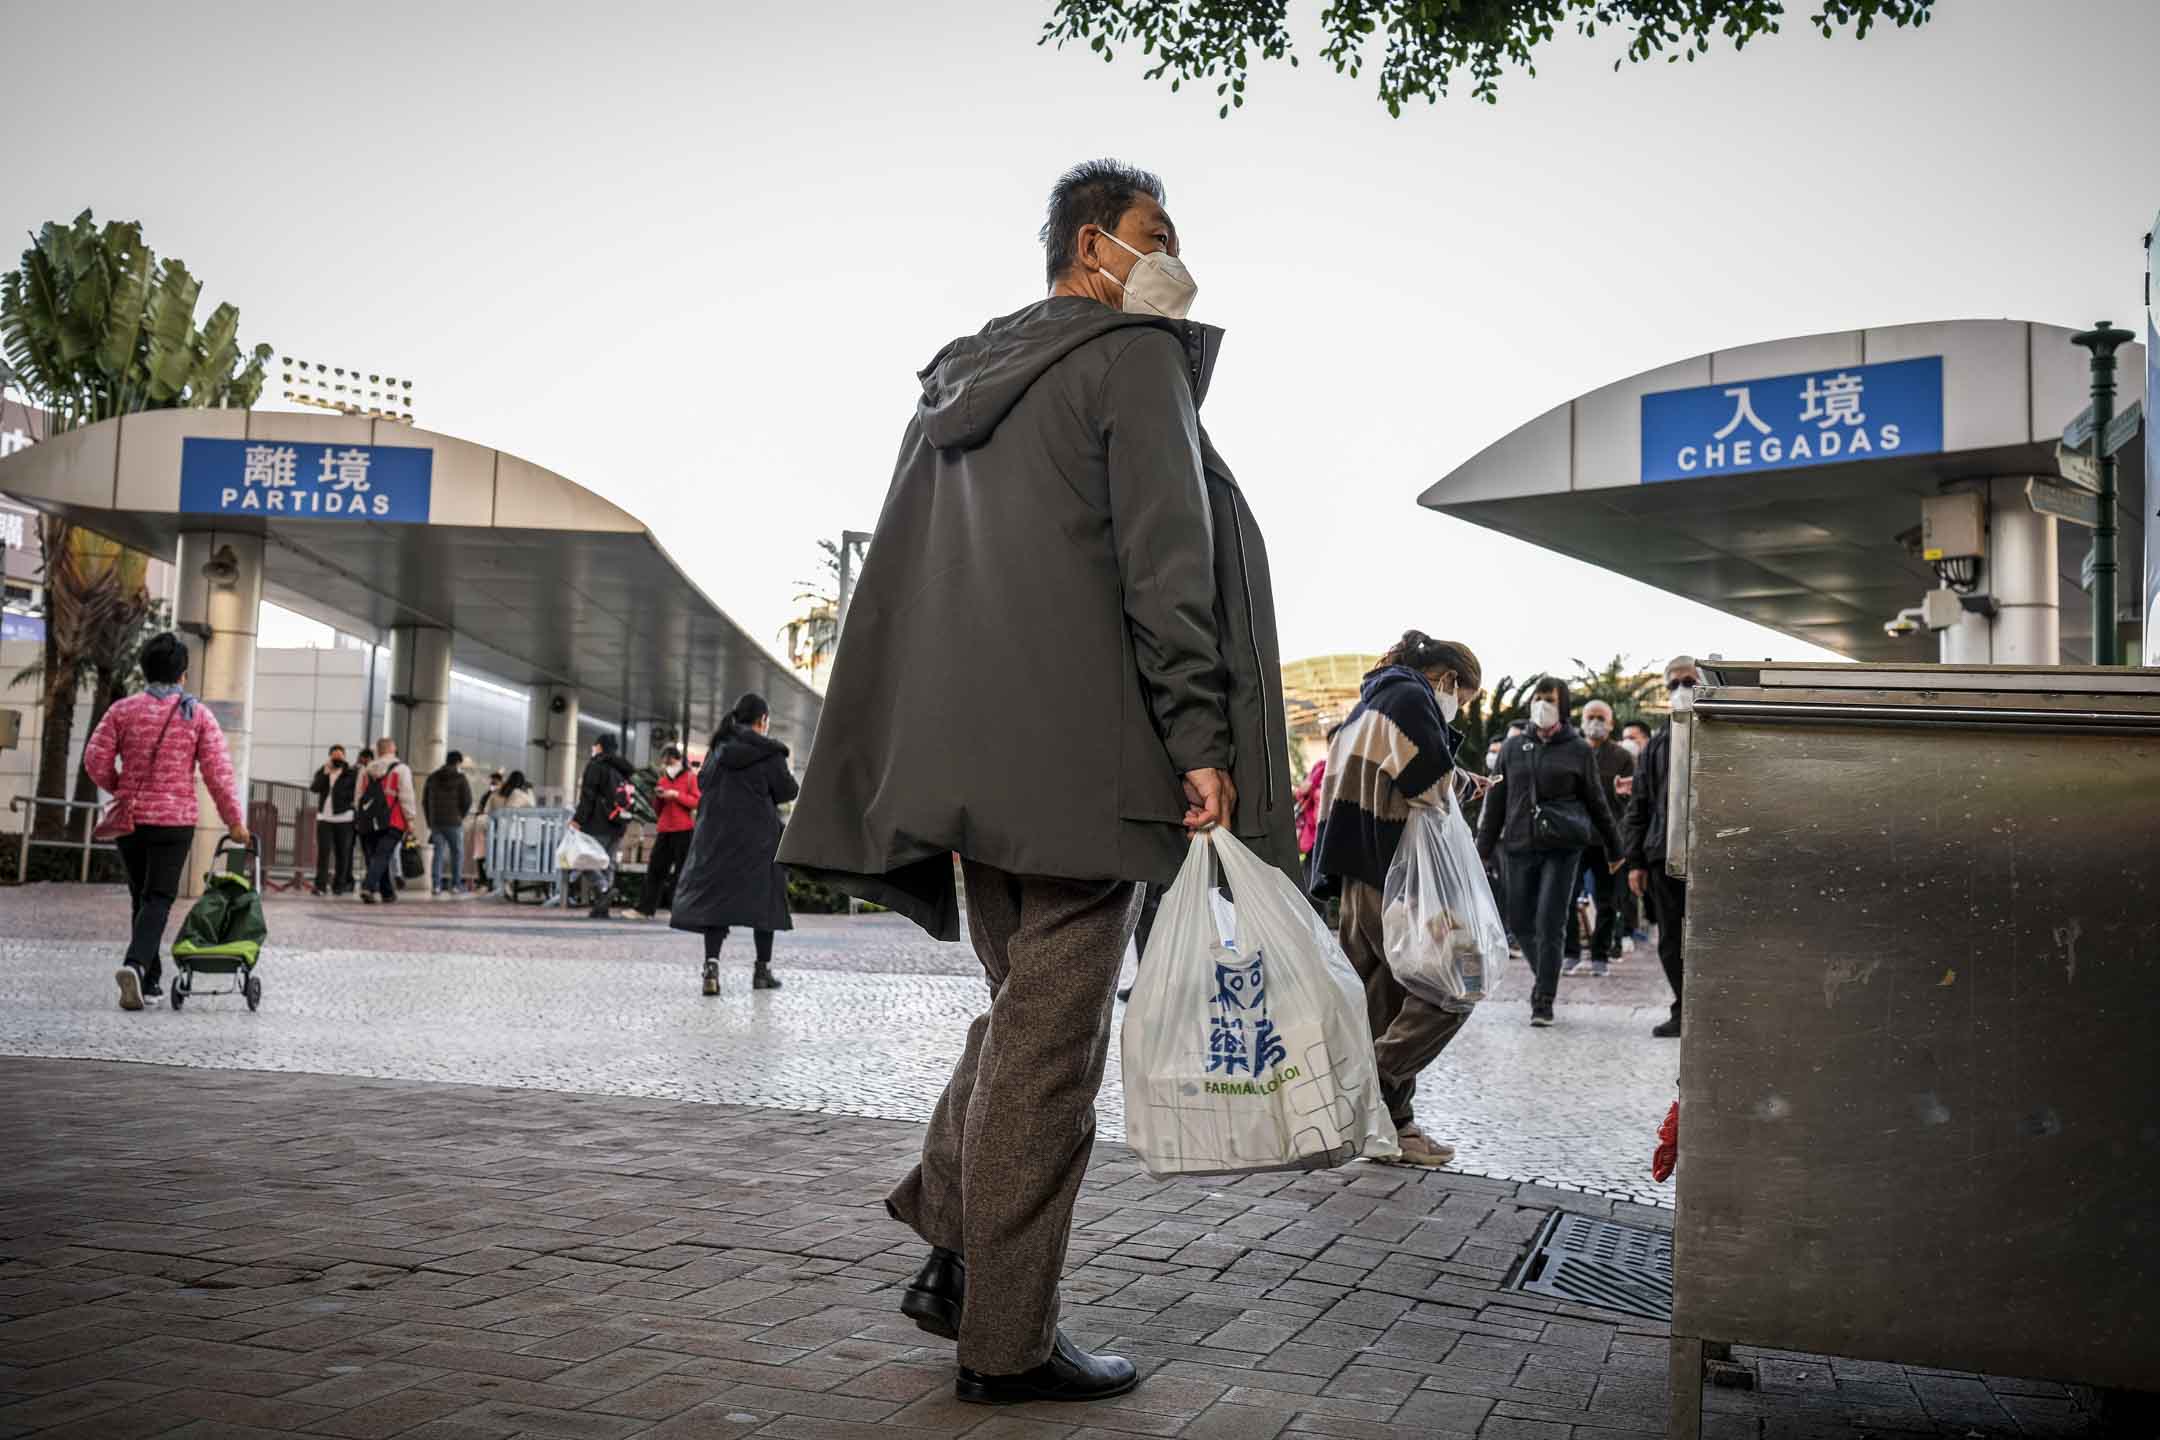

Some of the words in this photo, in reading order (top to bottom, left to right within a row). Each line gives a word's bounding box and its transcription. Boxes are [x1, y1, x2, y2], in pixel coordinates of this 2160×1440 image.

[1713, 373, 1866, 441] 入境
[244, 445, 371, 492] 離境
[1677, 423, 1901, 472] CHEGADAS
[221, 487, 390, 515] PARTIDAS
